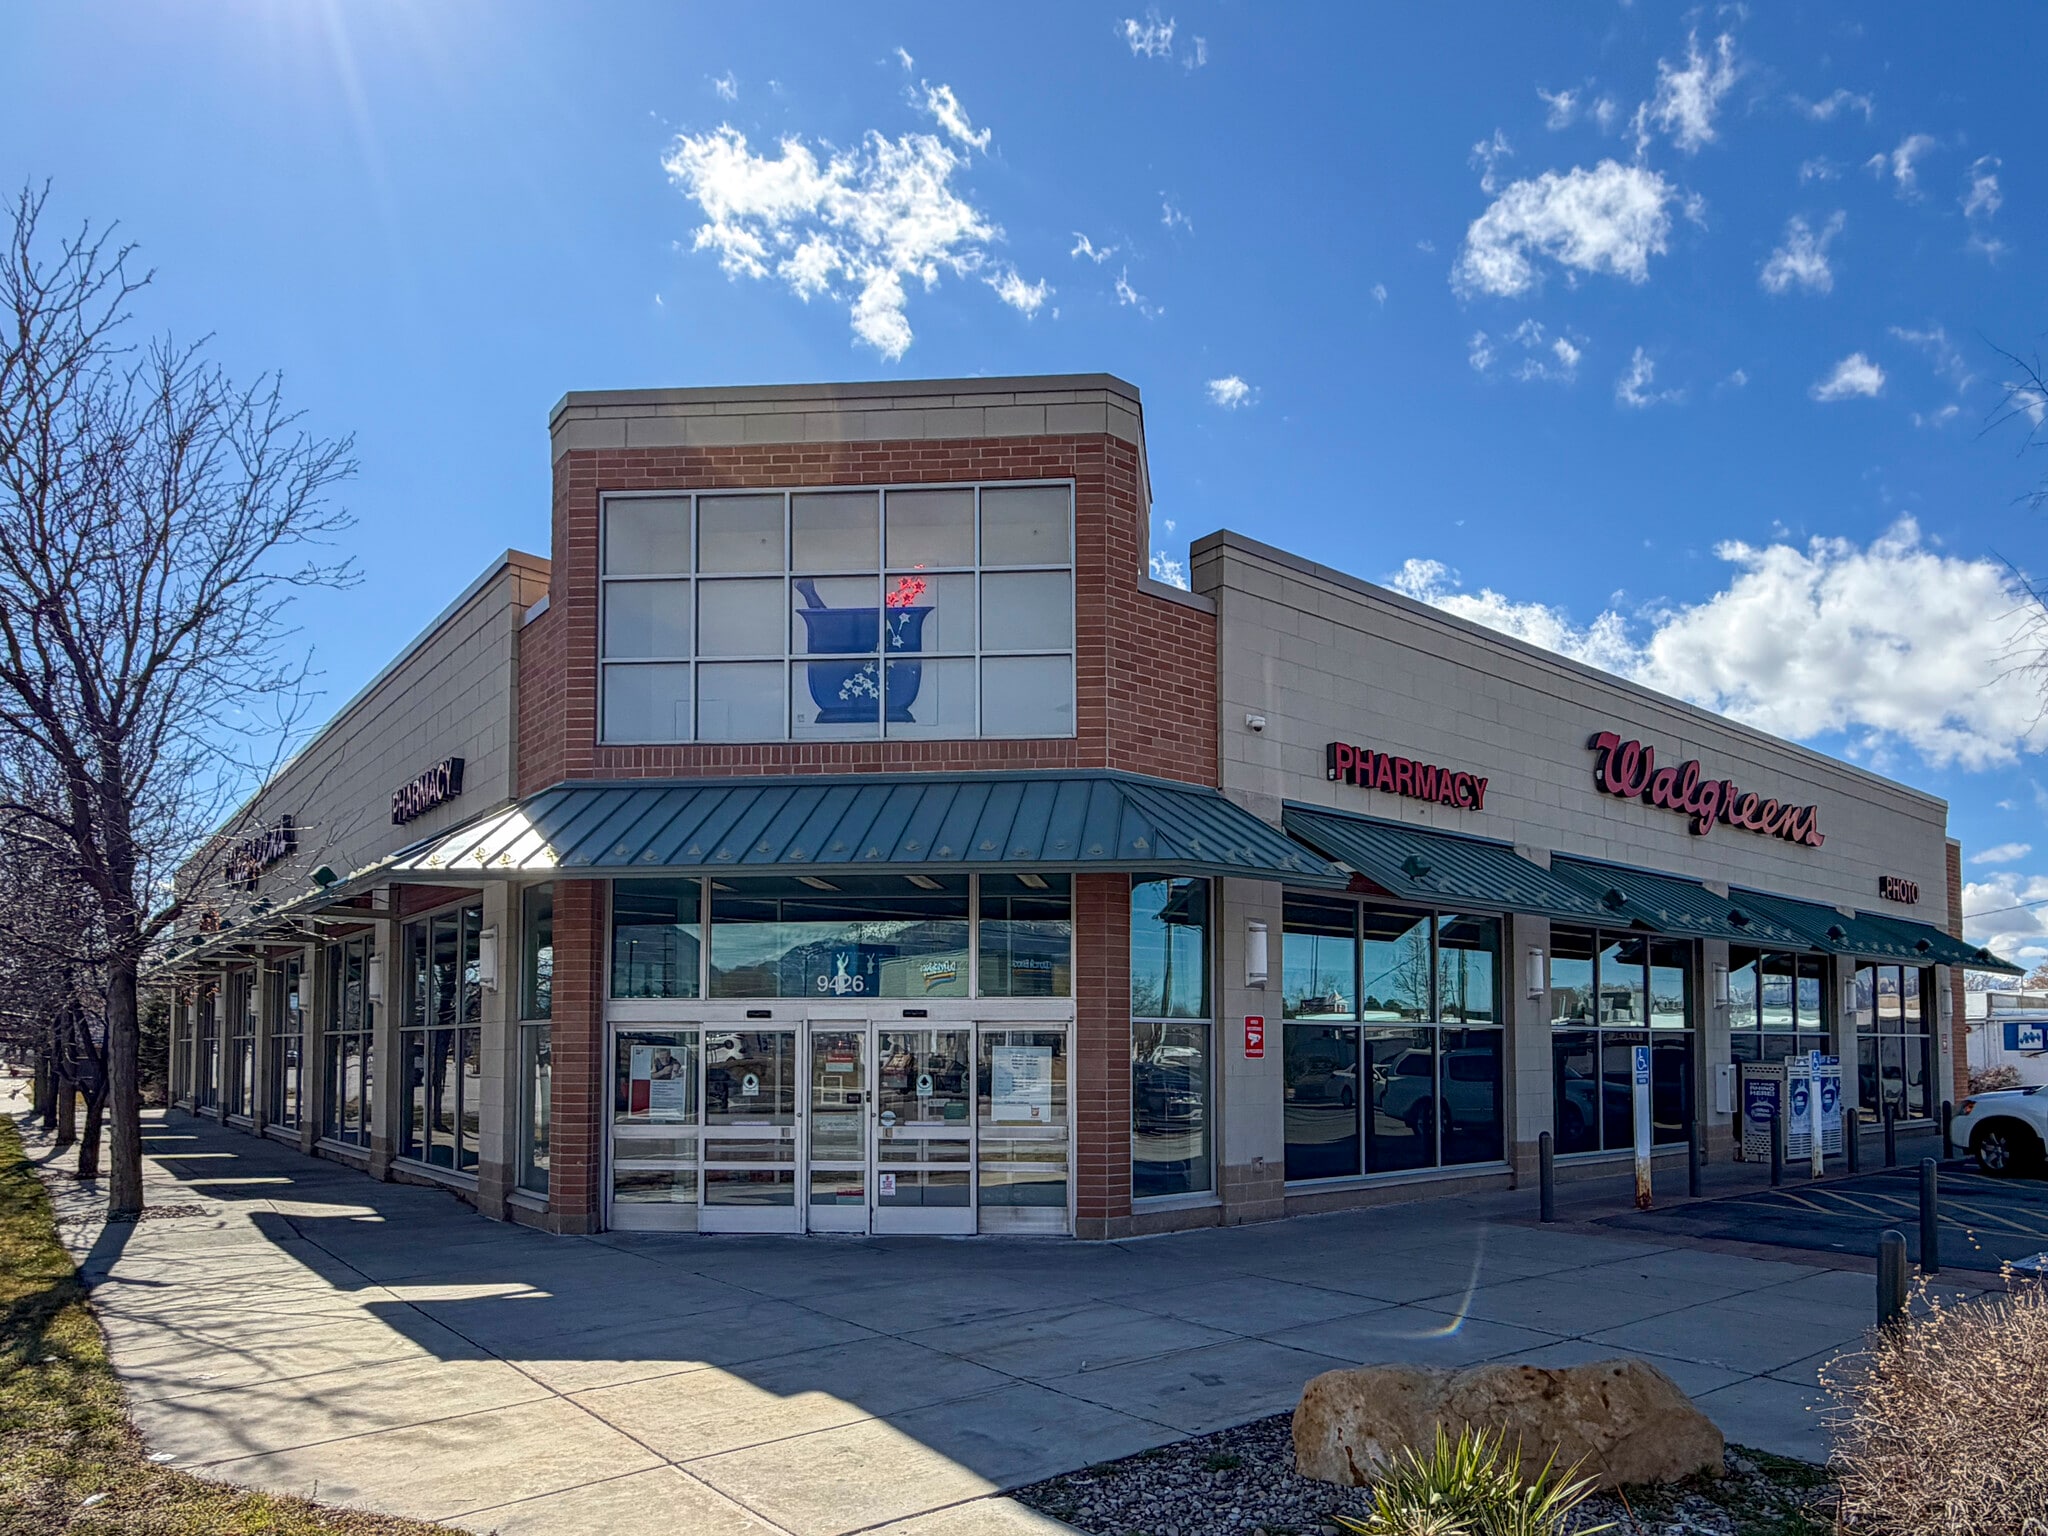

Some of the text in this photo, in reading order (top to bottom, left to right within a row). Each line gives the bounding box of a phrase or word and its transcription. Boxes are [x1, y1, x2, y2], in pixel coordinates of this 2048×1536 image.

[392, 757, 456, 824] PHARMACY
[1333, 742, 1488, 811] PHARMACY
[1592, 731, 1825, 847] Walgreens
[1886, 876, 1920, 904] PHOTO
[817, 975, 864, 993] 9426
